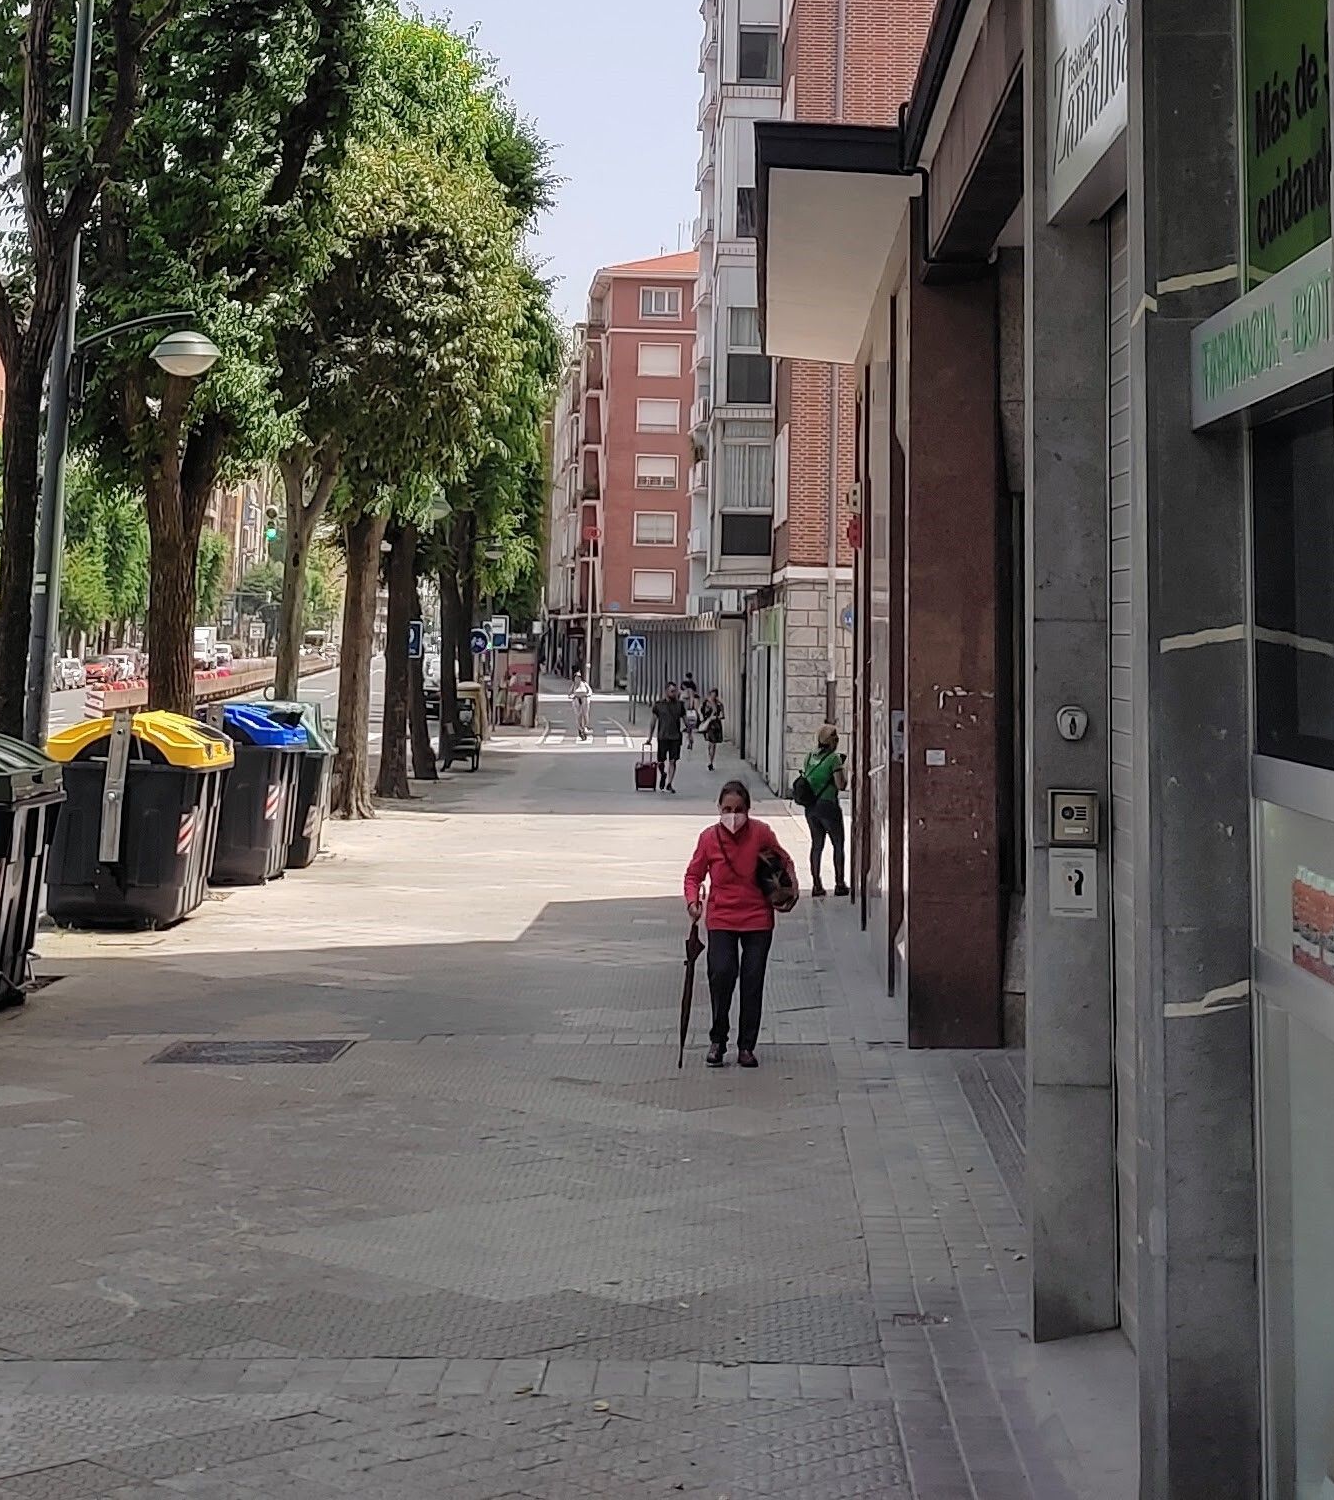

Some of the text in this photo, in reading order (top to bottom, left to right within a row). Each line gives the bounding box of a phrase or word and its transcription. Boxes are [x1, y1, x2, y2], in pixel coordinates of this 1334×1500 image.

[1255, 70, 1291, 157] Más
[1295, 43, 1318, 119] de
[1257, 127, 1330, 250] cuidand
[1201, 302, 1281, 401] FARMACIA
